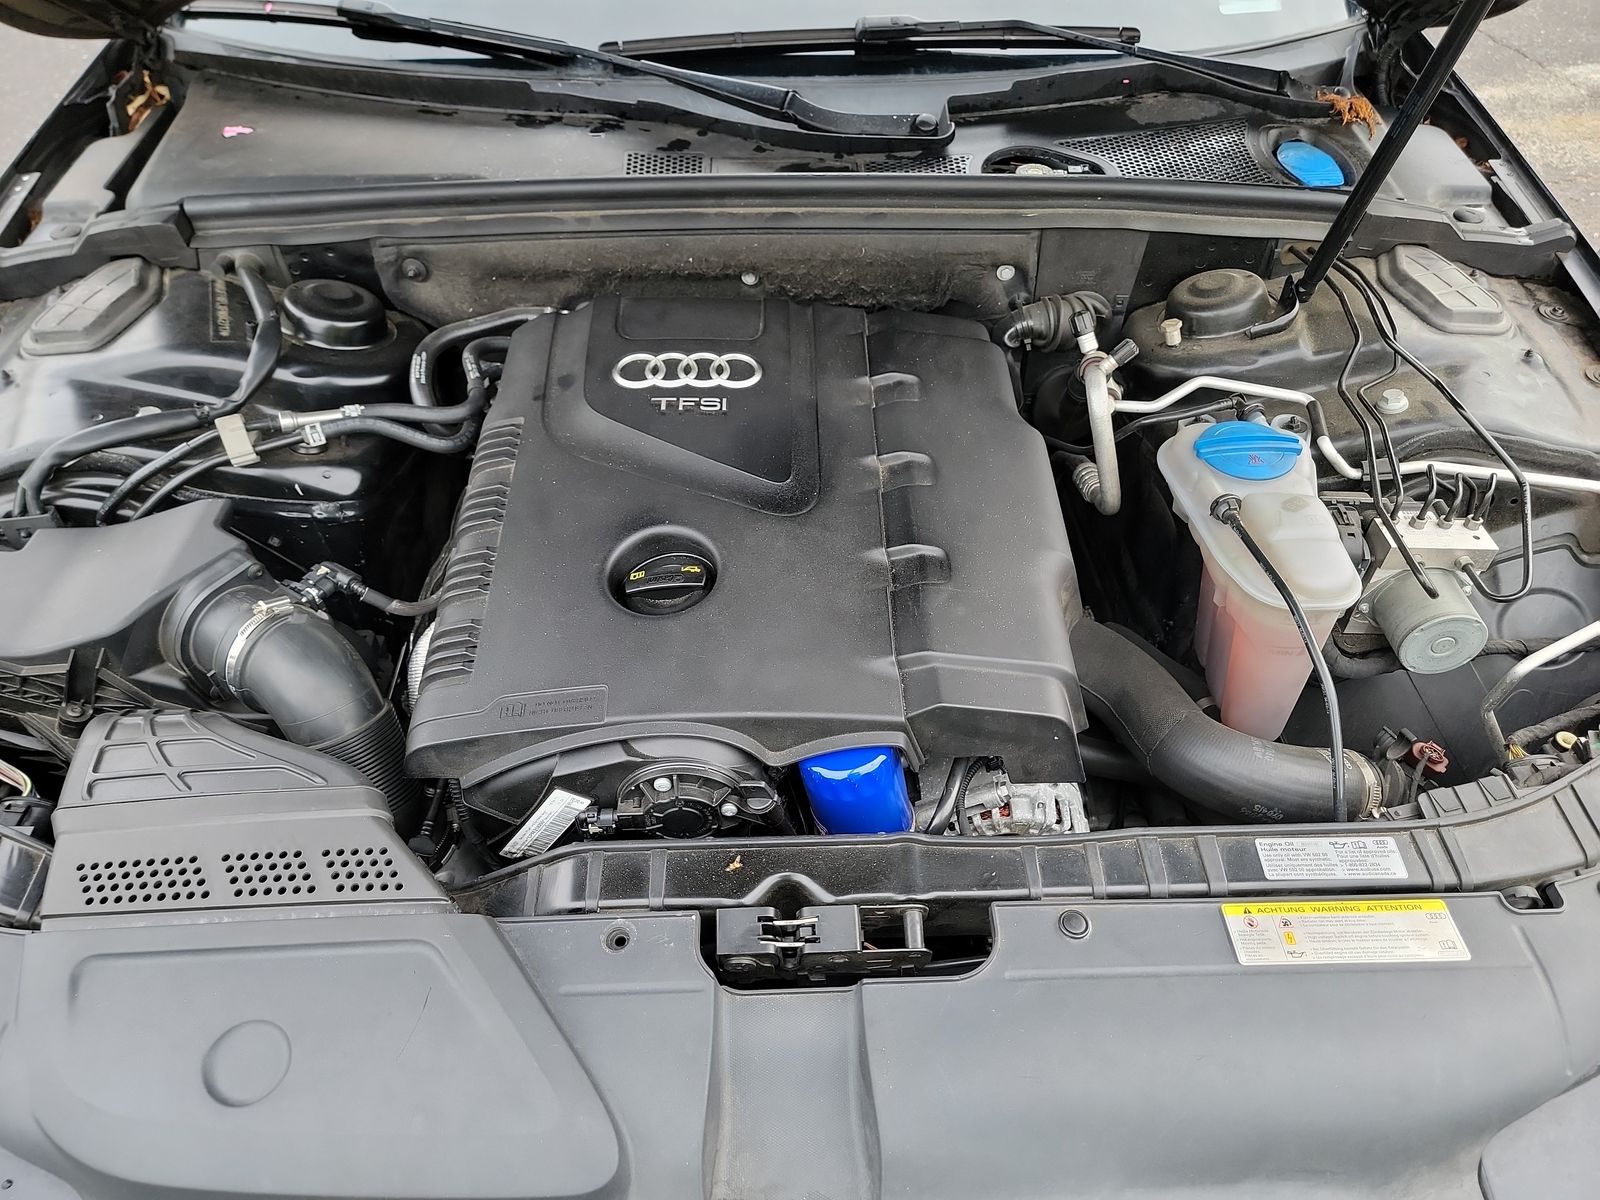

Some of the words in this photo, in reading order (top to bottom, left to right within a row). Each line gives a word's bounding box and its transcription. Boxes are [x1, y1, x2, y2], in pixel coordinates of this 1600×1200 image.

[651, 398, 727, 411] TFSI
[1257, 906, 1305, 914] ACHTUNG
[1311, 905, 1361, 913] WARNING
[1366, 904, 1423, 912] ATTENTION
